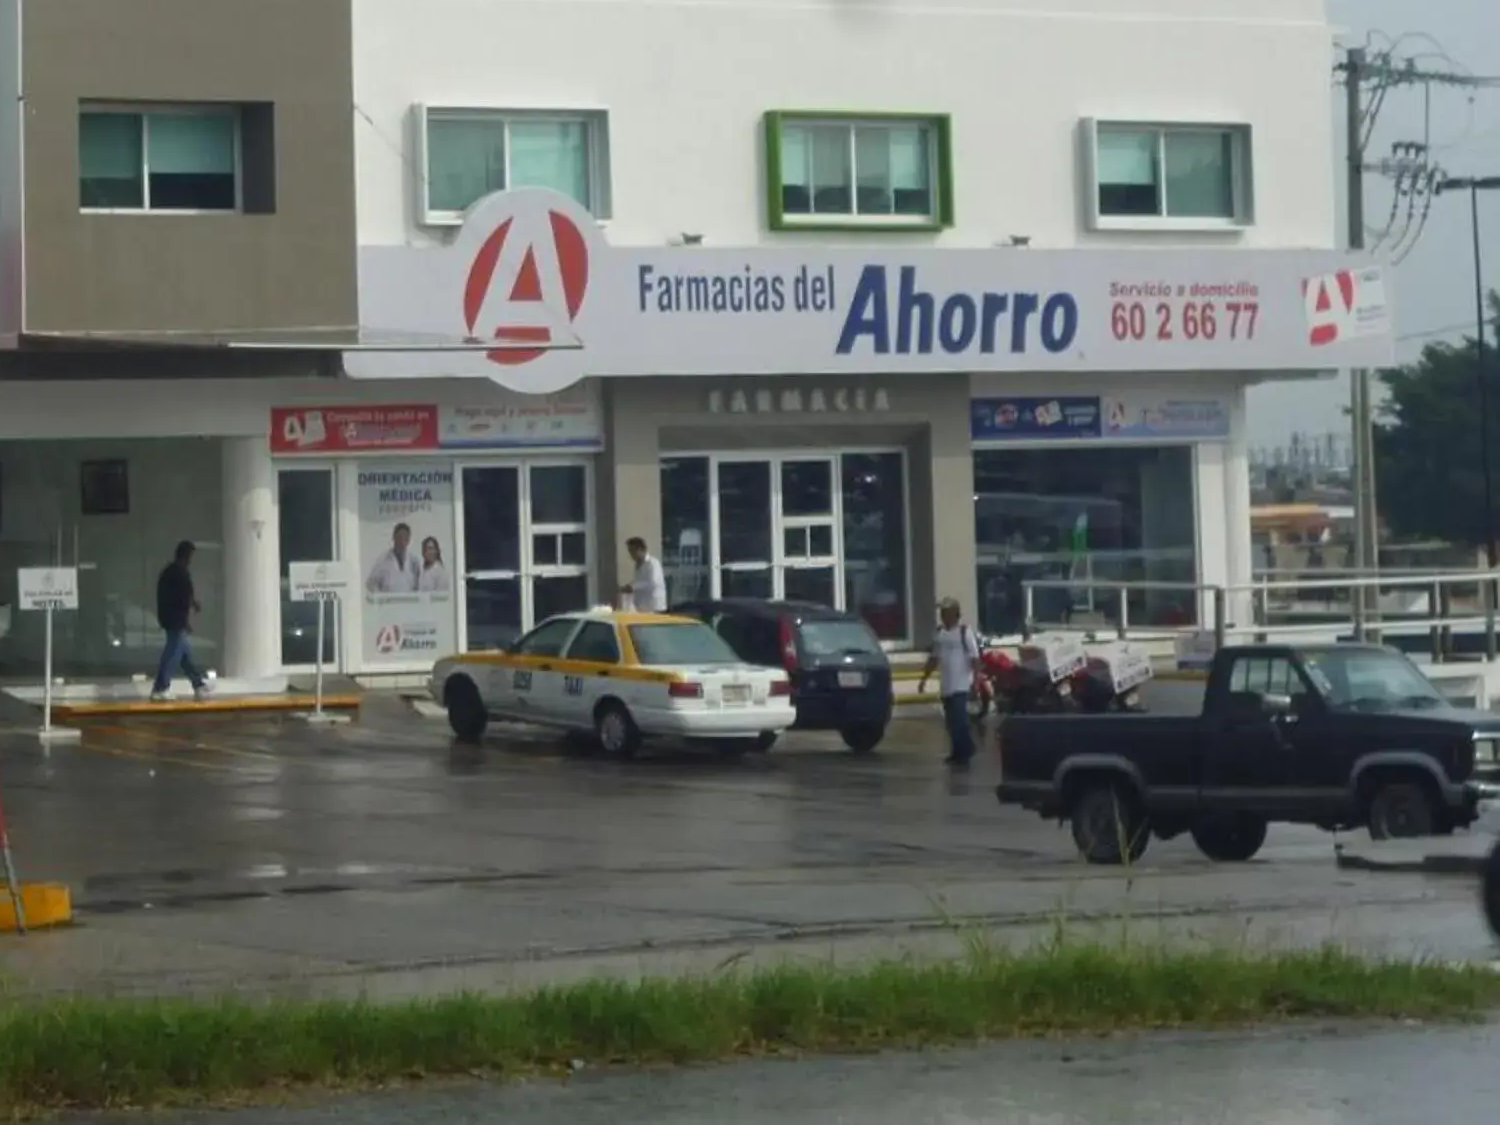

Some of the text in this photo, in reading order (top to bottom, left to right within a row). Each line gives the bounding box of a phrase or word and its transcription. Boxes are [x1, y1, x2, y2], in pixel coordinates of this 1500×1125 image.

[639, 265, 836, 313] Farmacias del
[1109, 282, 1171, 298] Servicio
[1190, 283, 1259, 297] domicilio
[835, 265, 1079, 355] Ahorro
[1111, 304, 1260, 341] 60 2 66 77
[379, 487, 432, 503] MÉDICA
